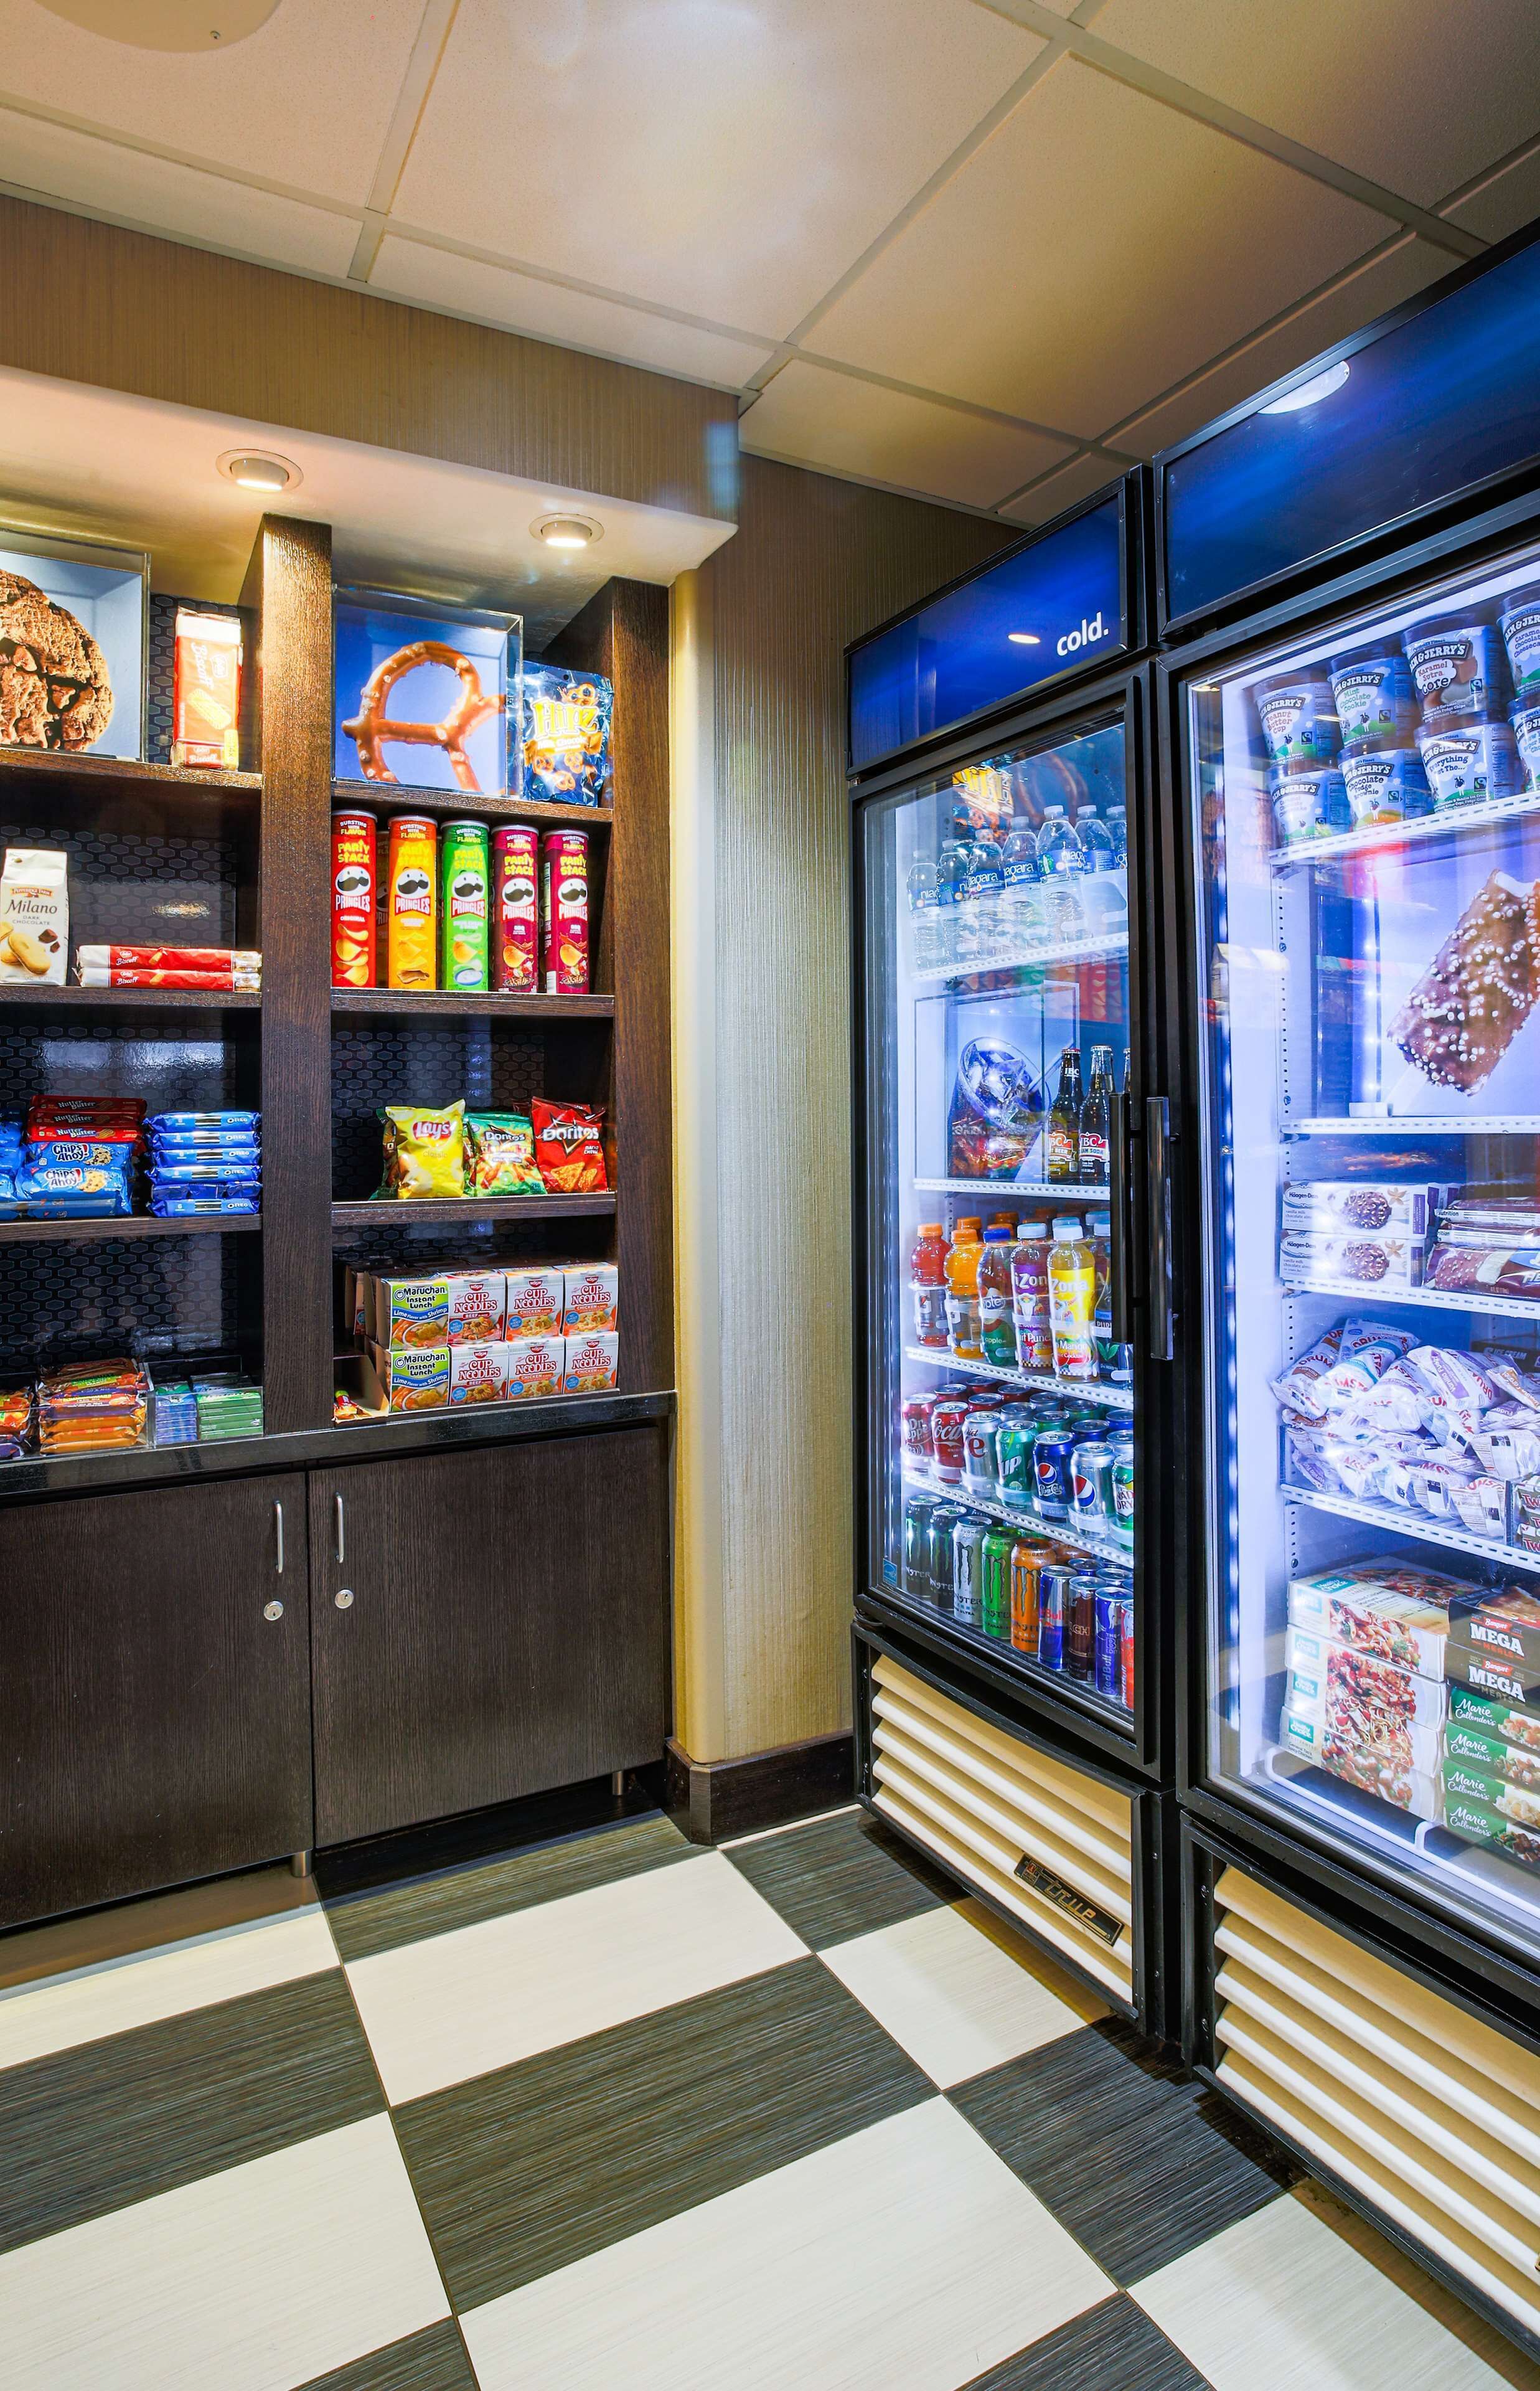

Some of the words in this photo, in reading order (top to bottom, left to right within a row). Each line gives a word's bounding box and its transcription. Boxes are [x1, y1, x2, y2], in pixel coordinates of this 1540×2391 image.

[1057, 611, 1109, 656] cold.
[337, 839, 370, 854] PARTY
[457, 836, 482, 844] FLAVOR
[507, 842, 532, 851] FLAVOR
[337, 852, 370, 864] STACK
[504, 852, 535, 867] PARTY
[560, 853, 587, 867] PARTY
[504, 865, 534, 876] STACK
[560, 865, 587, 877] STACK
[5, 899, 58, 915] Milano
[336, 894, 371, 914] PRINGLES
[395, 896, 431, 916] PRINGLES
[452, 900, 486, 918] PRINGLES
[502, 905, 535, 922] PRINGLES
[116, 956, 140, 966] Biscoff
[116, 976, 140, 985] Biscoff
[70, 1129, 96, 1138] Butter
[413, 1121, 453, 1140] Lay's
[485, 1131, 526, 1141] Doritos
[543, 1126, 599, 1141] Doritos
[52, 1143, 83, 1154] Chips
[1049, 1137, 1063, 1147] BC
[44, 1168, 75, 1179] Chips
[404, 1286, 445, 1297] Maruchan
[464, 1291, 489, 1303] CUP
[524, 1288, 548, 1299] CUP
[580, 1284, 604, 1296] CUP
[514, 1296, 556, 1309] NOODLES
[571, 1292, 611, 1306] NOODLES
[393, 1309, 408, 1318] Lime
[428, 1307, 448, 1318] Shrimp
[454, 1299, 497, 1314] NOODLES
[404, 1353, 445, 1364] Maruchan
[525, 1353, 550, 1365] CUP
[581, 1348, 604, 1360] CUP
[468, 1359, 494, 1370] CUP
[515, 1361, 557, 1375] NOODLES
[572, 1356, 611, 1370] NOODLES
[393, 1377, 408, 1385] Lime
[428, 1374, 448, 1384] Shrimp
[458, 1366, 501, 1381] NOODLES
[1470, 1623, 1525, 1657] MEGA
[1468, 1665, 1526, 1703] MEGA
[1455, 1698, 1493, 1718] Marie
[1455, 1709, 1496, 1727] Callender's
[1450, 1733, 1489, 1754] Marie
[1450, 1743, 1492, 1763] Callender's
[1447, 1771, 1487, 1793] Marie
[1447, 1781, 1490, 1801] Callender's
[1450, 1806, 1489, 1828] Marie
[1450, 1816, 1492, 1837] Callender's
